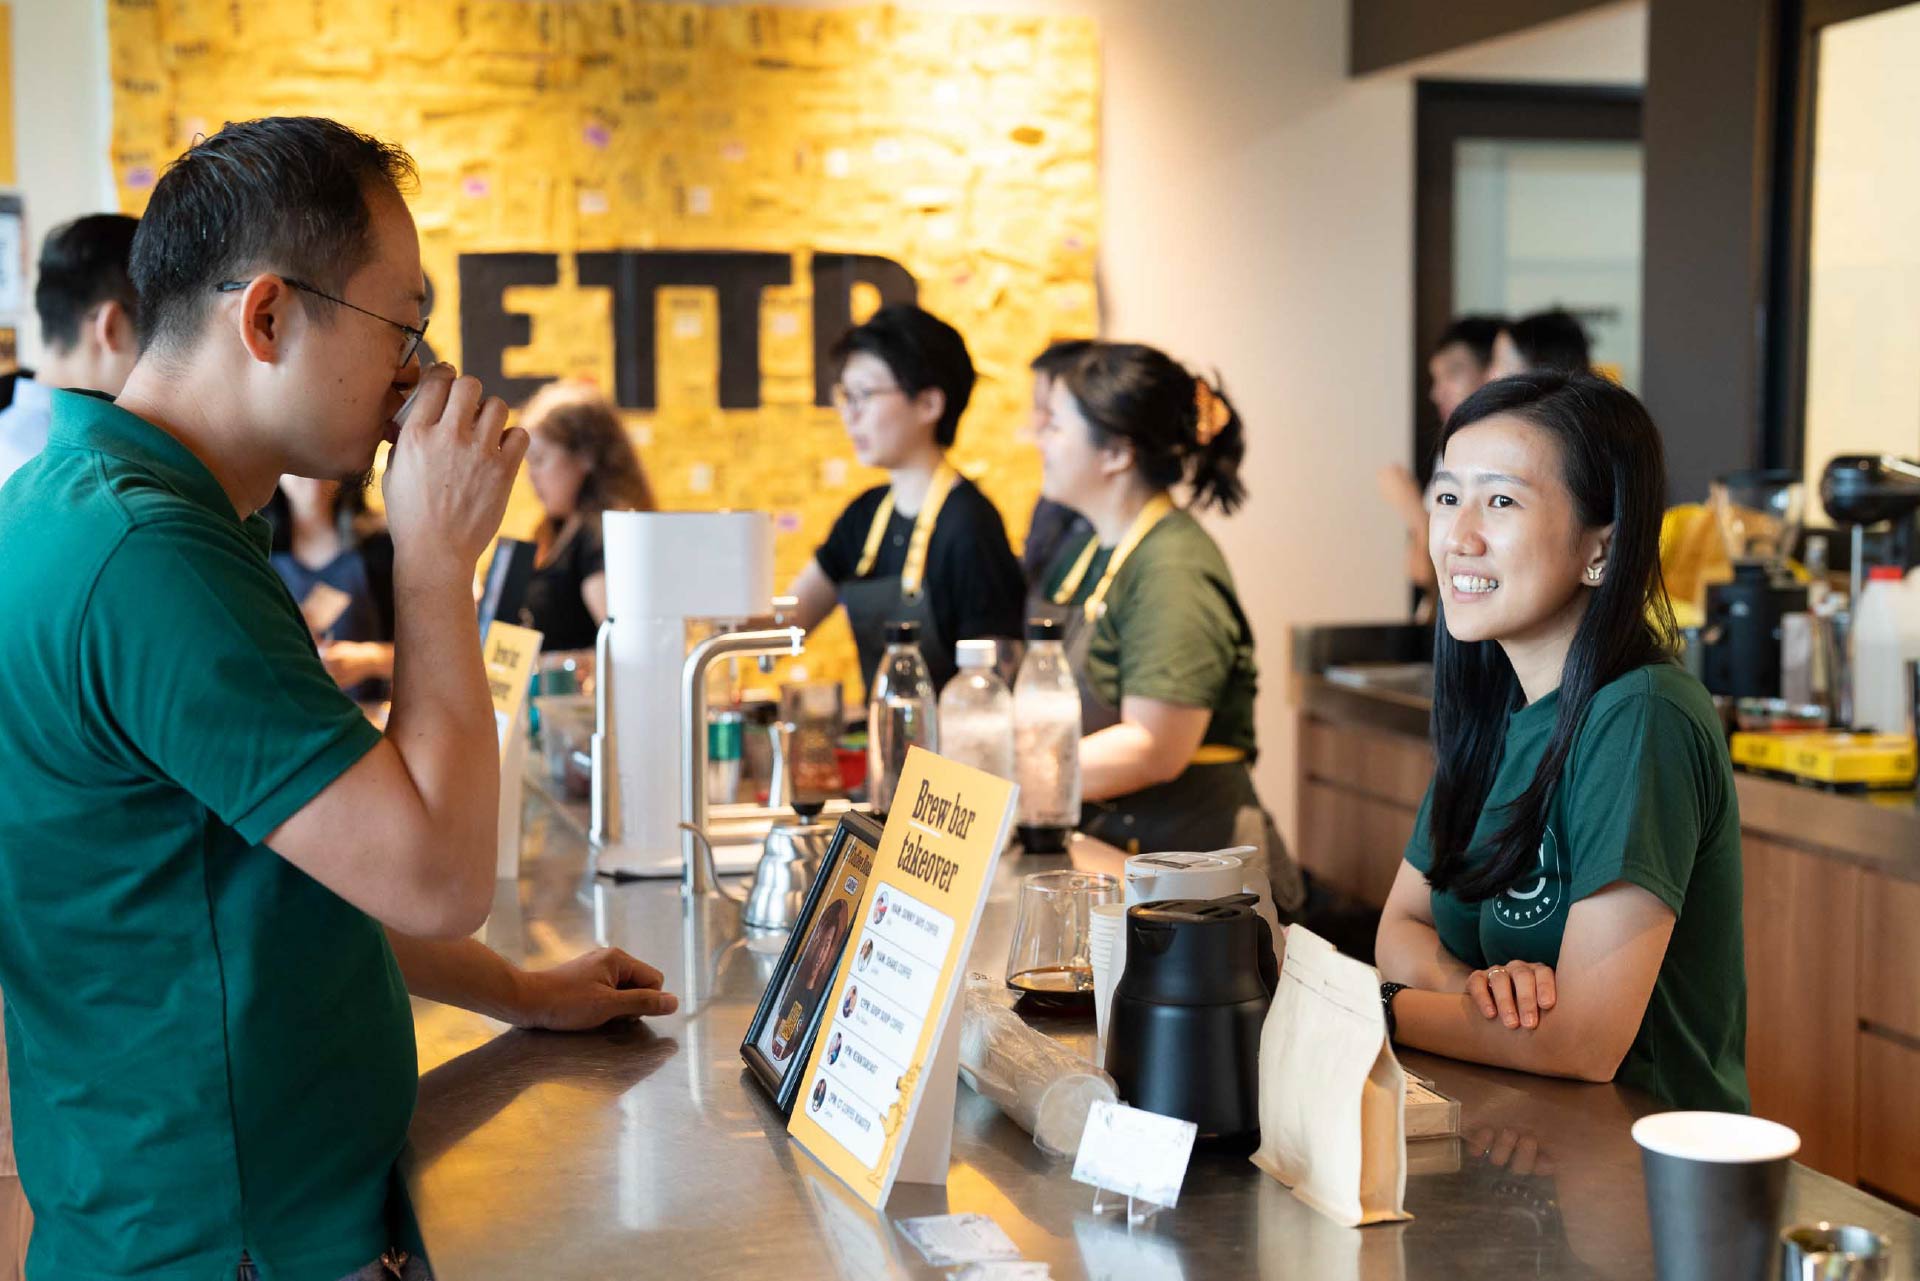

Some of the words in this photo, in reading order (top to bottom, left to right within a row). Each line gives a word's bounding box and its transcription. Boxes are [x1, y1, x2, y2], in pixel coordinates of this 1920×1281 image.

[911, 778, 952, 830] Brew
[948, 792, 976, 840] bar
[897, 831, 959, 893] takeover
[1494, 894, 1551, 921] OASTER
